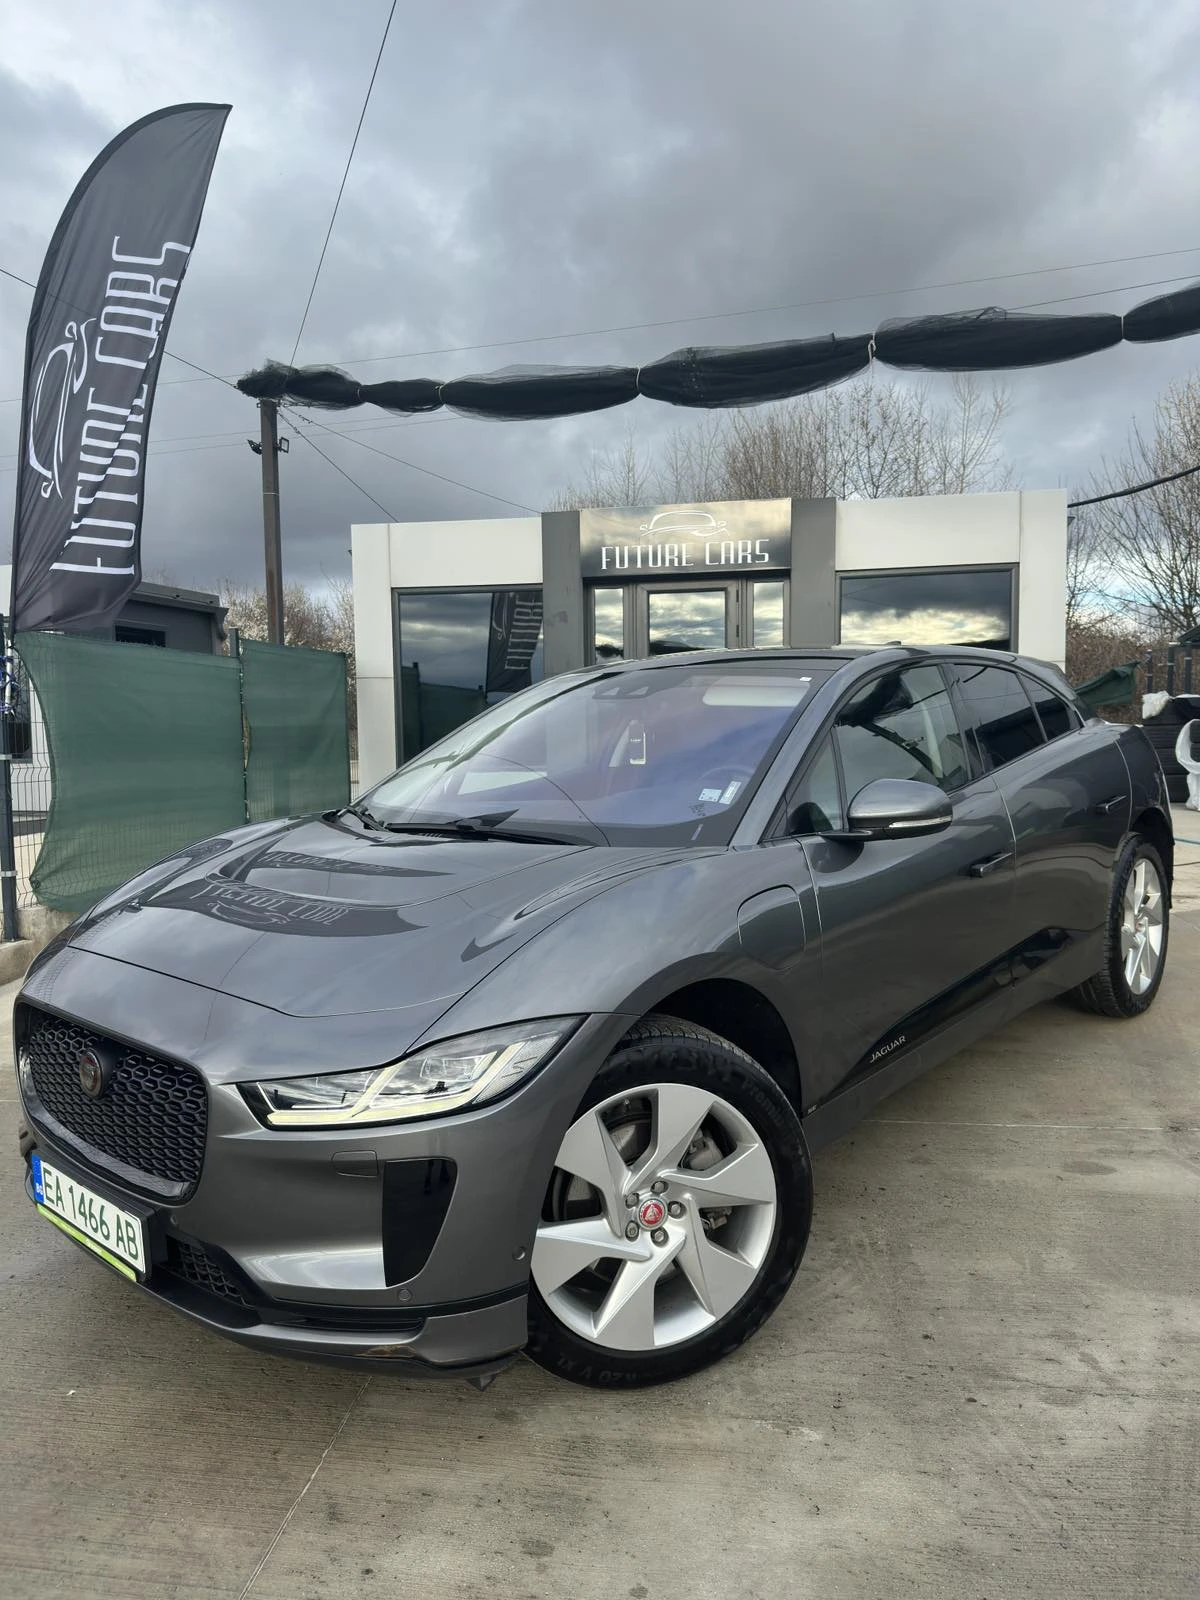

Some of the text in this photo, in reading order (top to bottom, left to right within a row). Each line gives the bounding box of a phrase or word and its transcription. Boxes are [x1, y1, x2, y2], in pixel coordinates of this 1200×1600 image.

[95, 234, 191, 370] CARS
[600, 539, 770, 570] FUTURE CARS
[869, 1035, 906, 1064] JAGUAR
[42, 1167, 65, 1213] EA
[68, 1185, 110, 1241] 1466
[116, 1214, 139, 1261] AB
